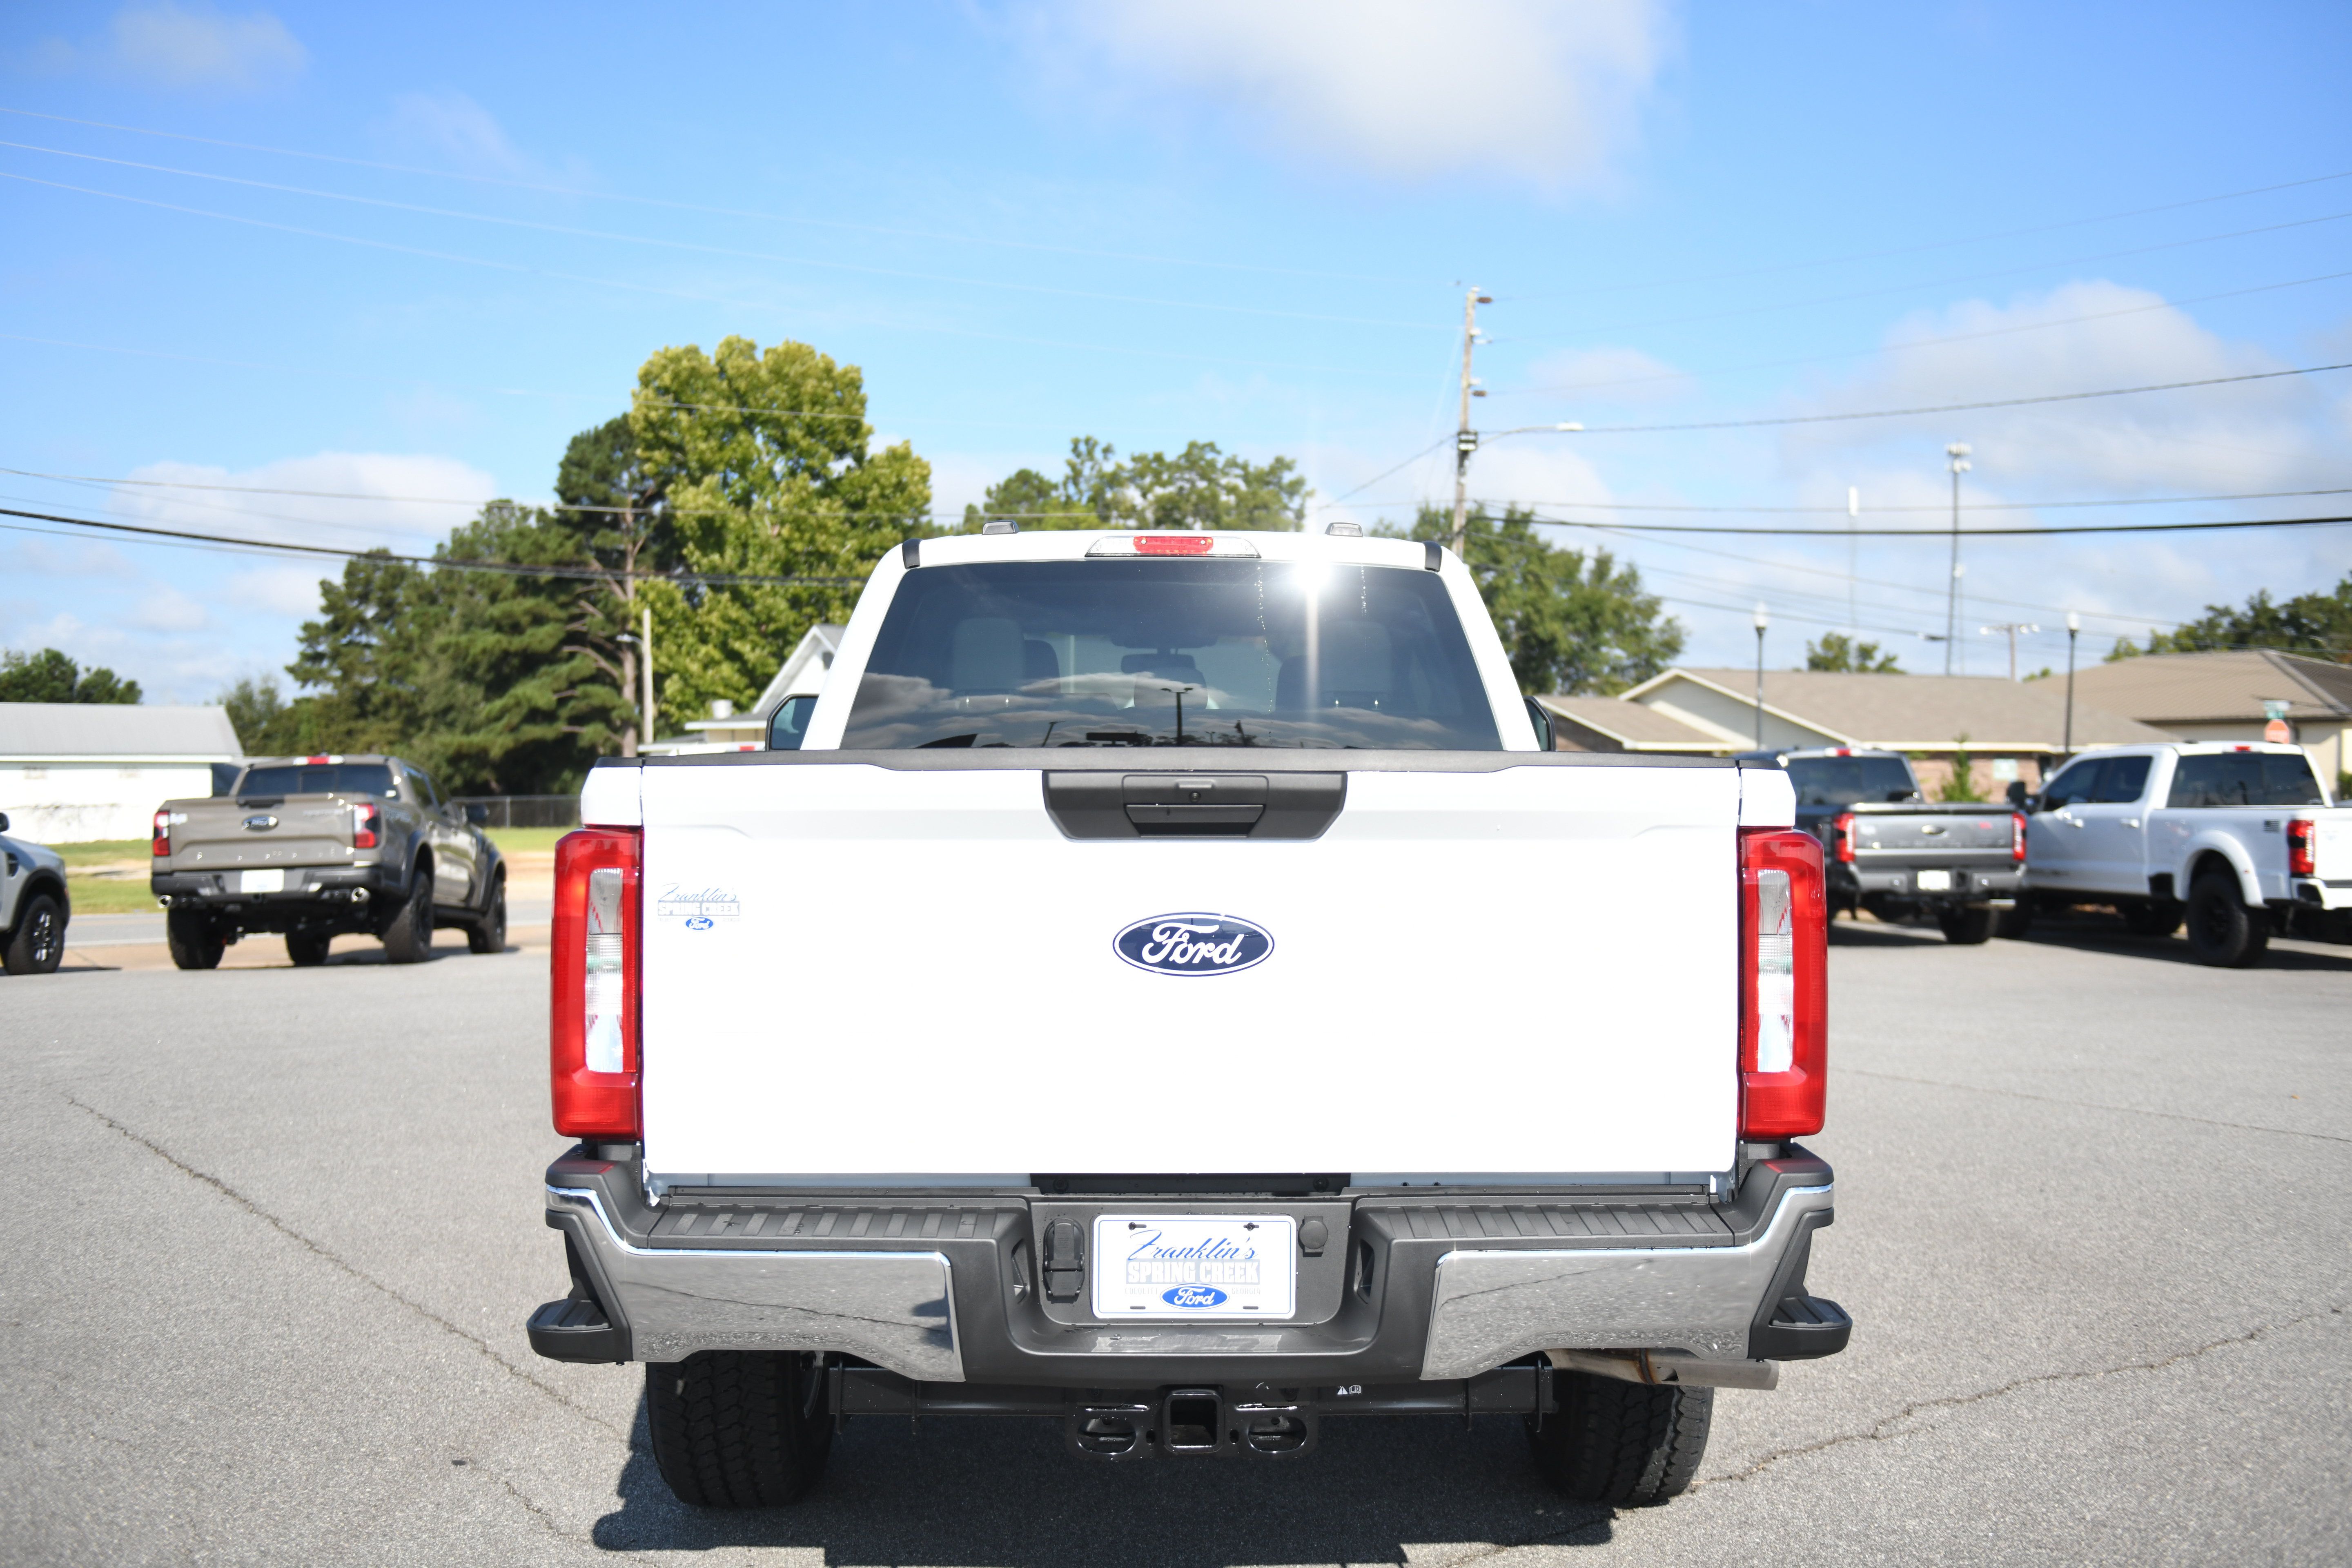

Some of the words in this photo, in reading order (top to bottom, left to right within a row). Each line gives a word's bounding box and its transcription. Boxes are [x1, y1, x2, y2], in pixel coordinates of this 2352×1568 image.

[659, 883, 737, 902] Franklin's
[658, 902, 700, 915] SPRING
[702, 902, 739, 915] CREEK
[688, 917, 710, 929] Ford
[1142, 922, 1245, 964] Ford
[1127, 1229, 1258, 1261] Franklin's
[1128, 1261, 1196, 1283] SPRING
[1199, 1261, 1258, 1283] CREEK
[1174, 1287, 1215, 1305] Ford
